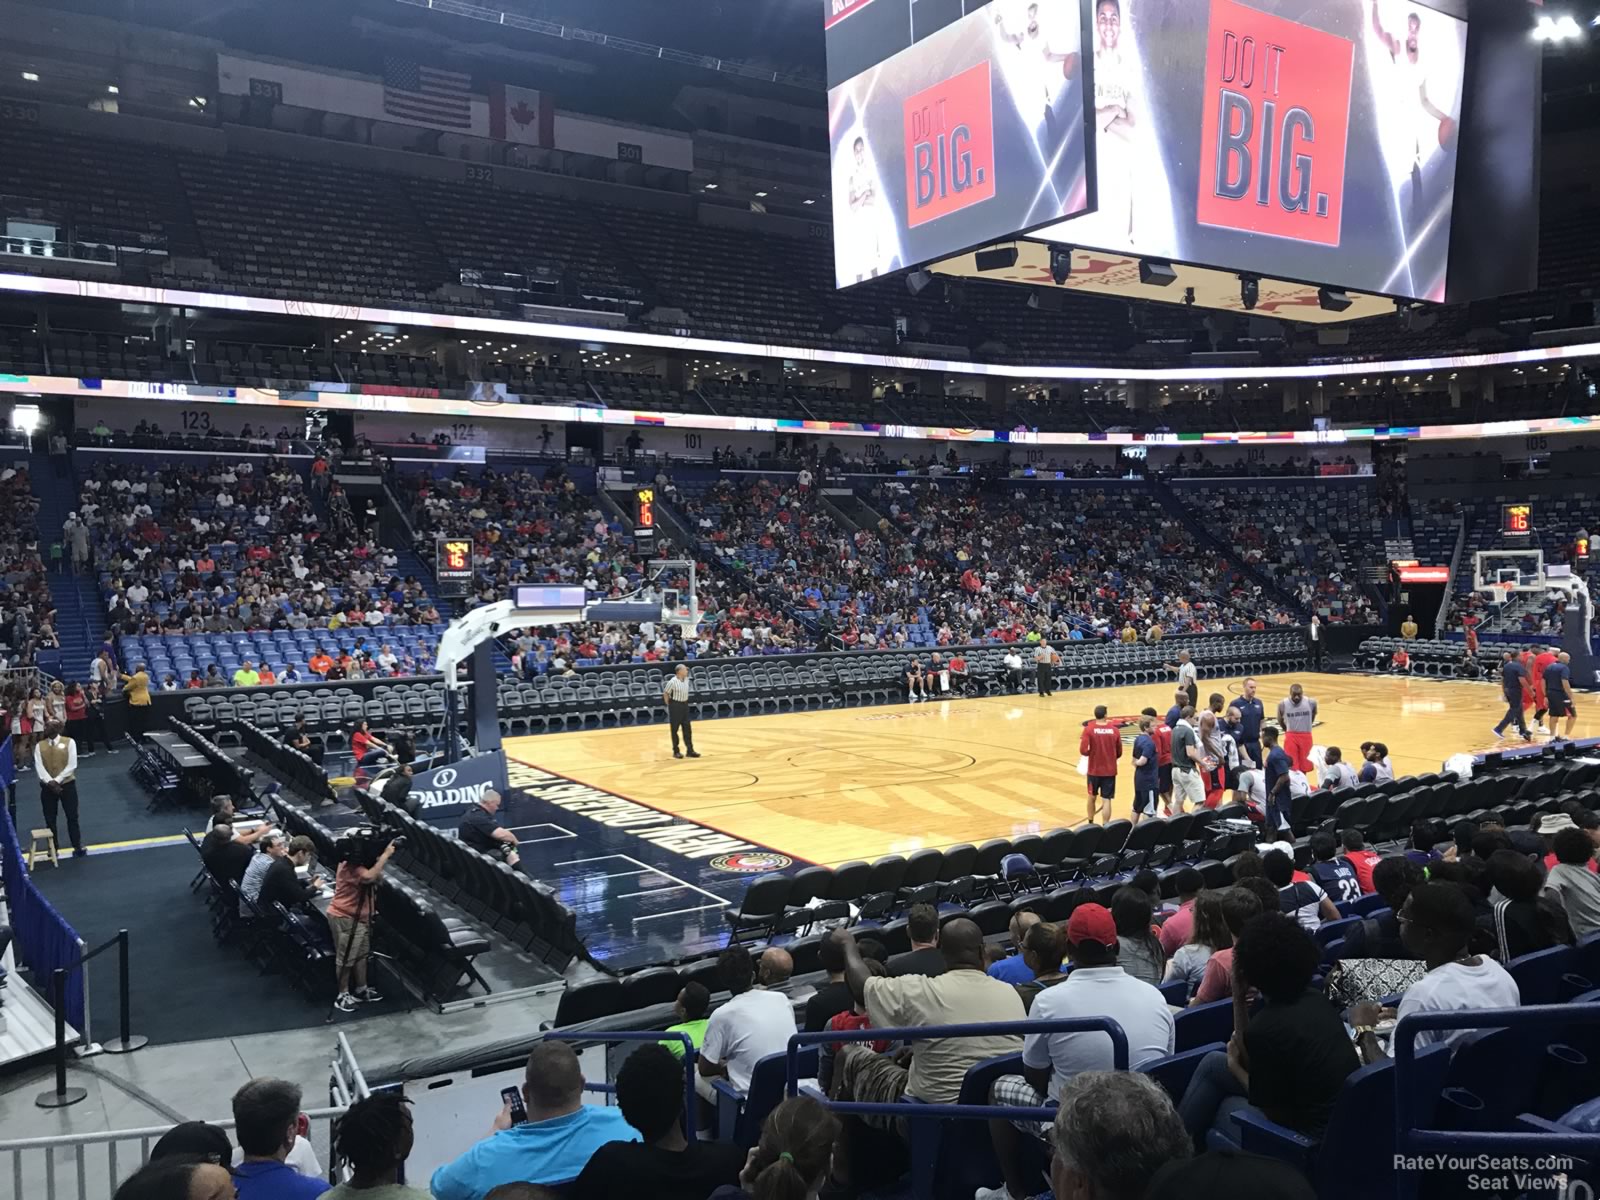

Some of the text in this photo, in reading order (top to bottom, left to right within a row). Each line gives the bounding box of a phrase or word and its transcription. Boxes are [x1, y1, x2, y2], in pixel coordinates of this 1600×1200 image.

[1221, 29, 1286, 98] DO IT
[253, 82, 280, 99] 331
[912, 97, 947, 141] DO IT
[619, 146, 641, 160] 301
[1213, 87, 1329, 218] BIG.
[466, 166, 493, 182] 332
[914, 123, 985, 208] BIG.
[808, 224, 829, 239] 302
[1066, 266, 1139, 287] SMOOTH
[181, 411, 210, 429] 123
[451, 423, 475, 440] 124
[885, 424, 895, 436] DO
[895, 425, 903, 437] IT
[684, 433, 702, 449] 101
[1526, 436, 1548, 450] 105
[864, 444, 881, 458] 102
[1026, 450, 1044, 463] 103
[1512, 515, 1527, 530] 16
[449, 553, 464, 568] 16
[408, 780, 493, 808] PALDING
[523, 783, 674, 827] ORLEANS
[624, 823, 758, 859] NEW
[1334, 867, 1352, 878] DAVIS
[1338, 877, 1362, 901] 23
